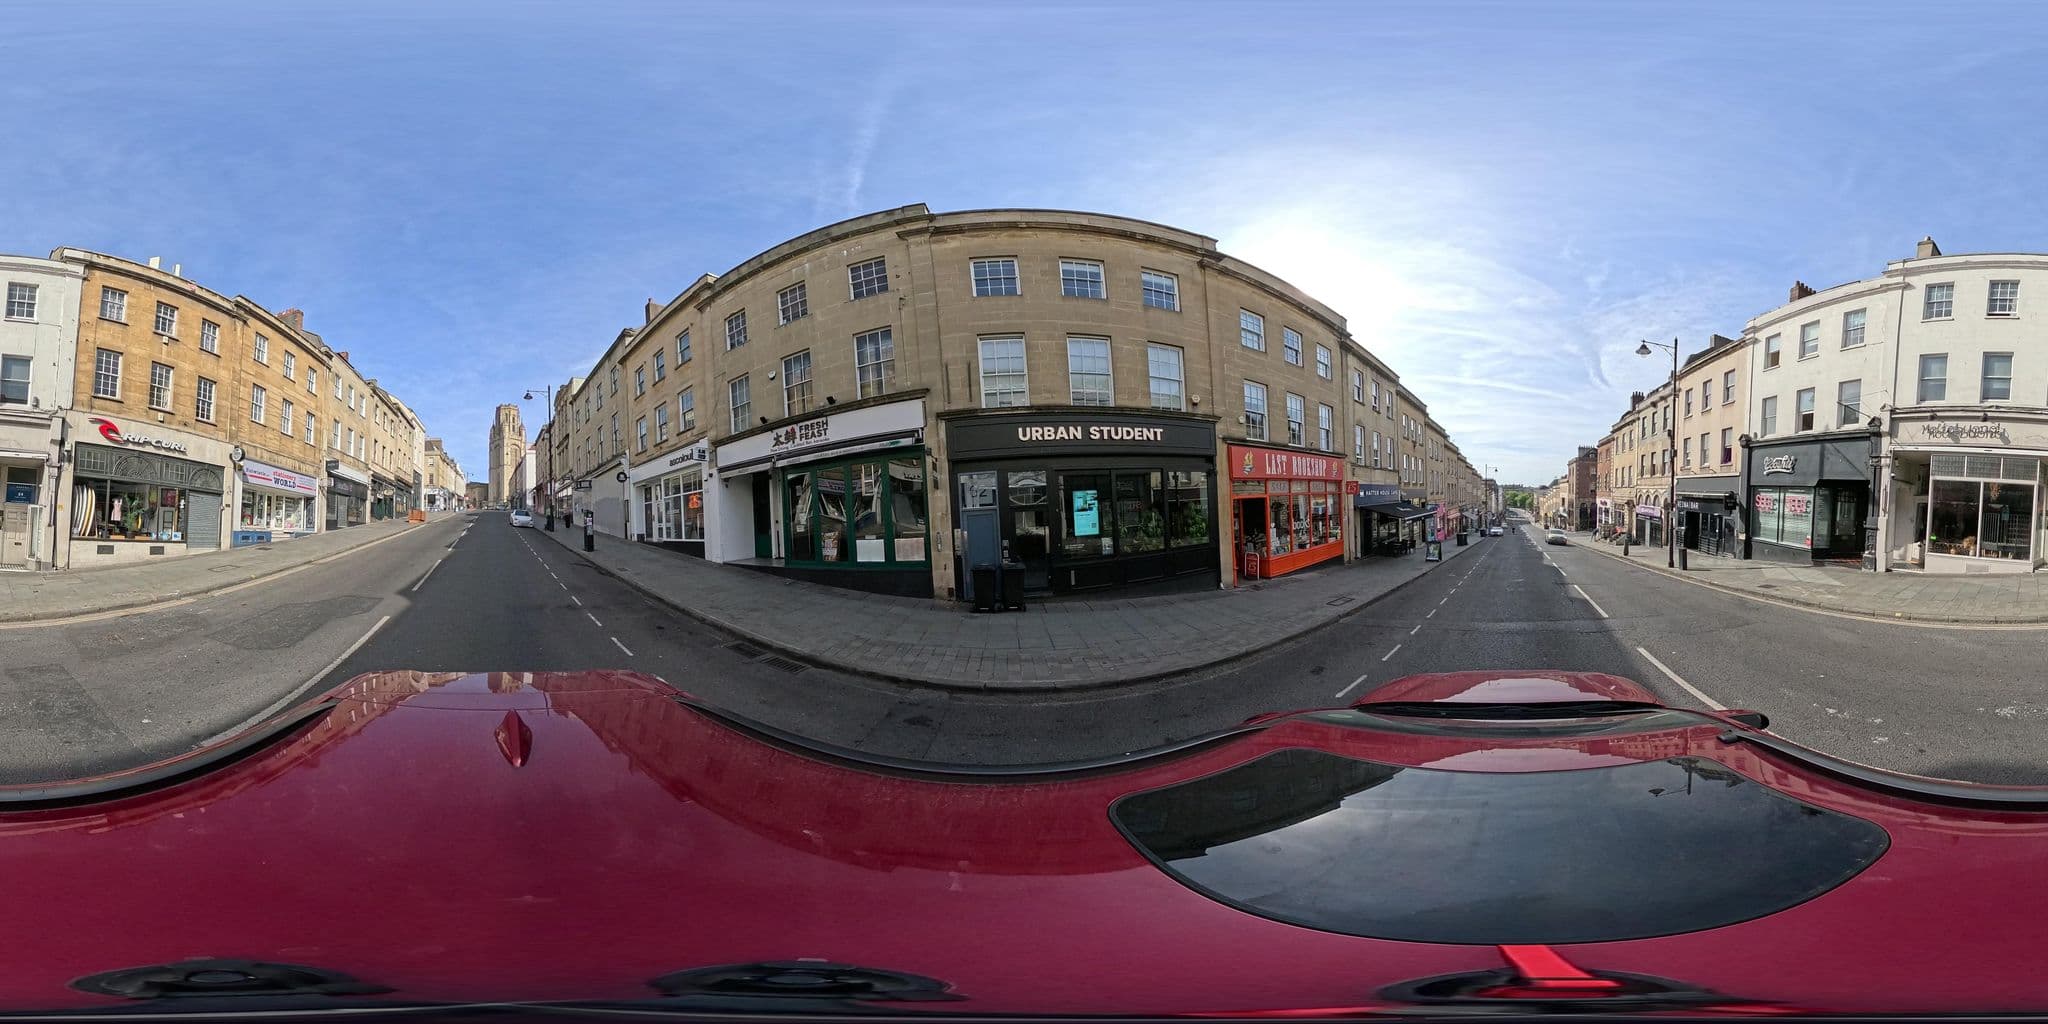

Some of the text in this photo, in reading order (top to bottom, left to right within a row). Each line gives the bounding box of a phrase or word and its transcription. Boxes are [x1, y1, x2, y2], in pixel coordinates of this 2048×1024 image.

[799, 420, 829, 433] FRESH
[799, 428, 829, 441] FEAST
[1018, 426, 1163, 442] URBAN STUDENT
[122, 432, 187, 452] RIP CURL
[1265, 453, 1327, 477] LAST BOOKSHOP
[273, 477, 297, 489] WORLD
